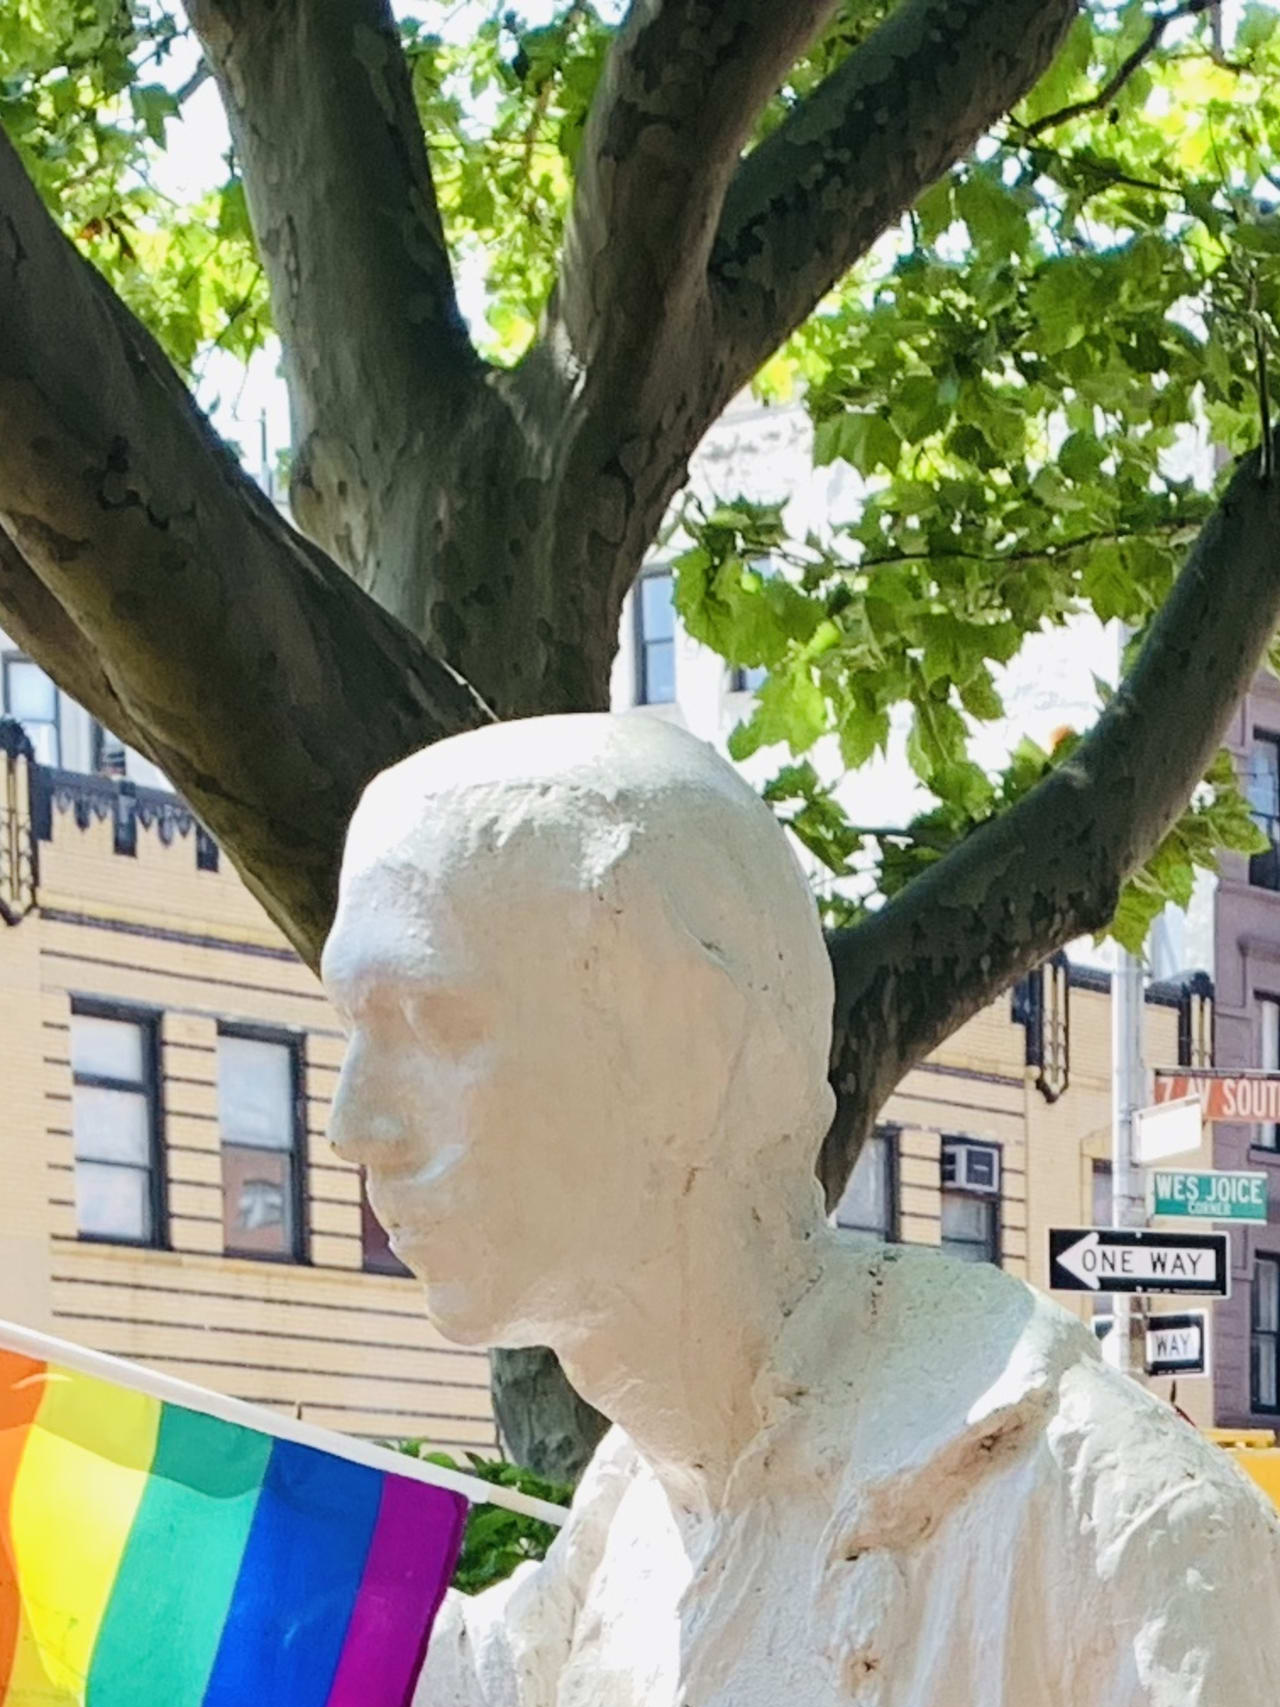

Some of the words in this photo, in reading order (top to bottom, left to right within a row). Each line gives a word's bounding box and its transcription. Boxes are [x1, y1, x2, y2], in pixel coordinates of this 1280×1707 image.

[1156, 1174, 1200, 1200] WES
[1206, 1177, 1264, 1204] JOICE
[1081, 1249, 1134, 1273] ONE
[1150, 1251, 1202, 1275] WAY
[1155, 1333, 1190, 1357] WAY
